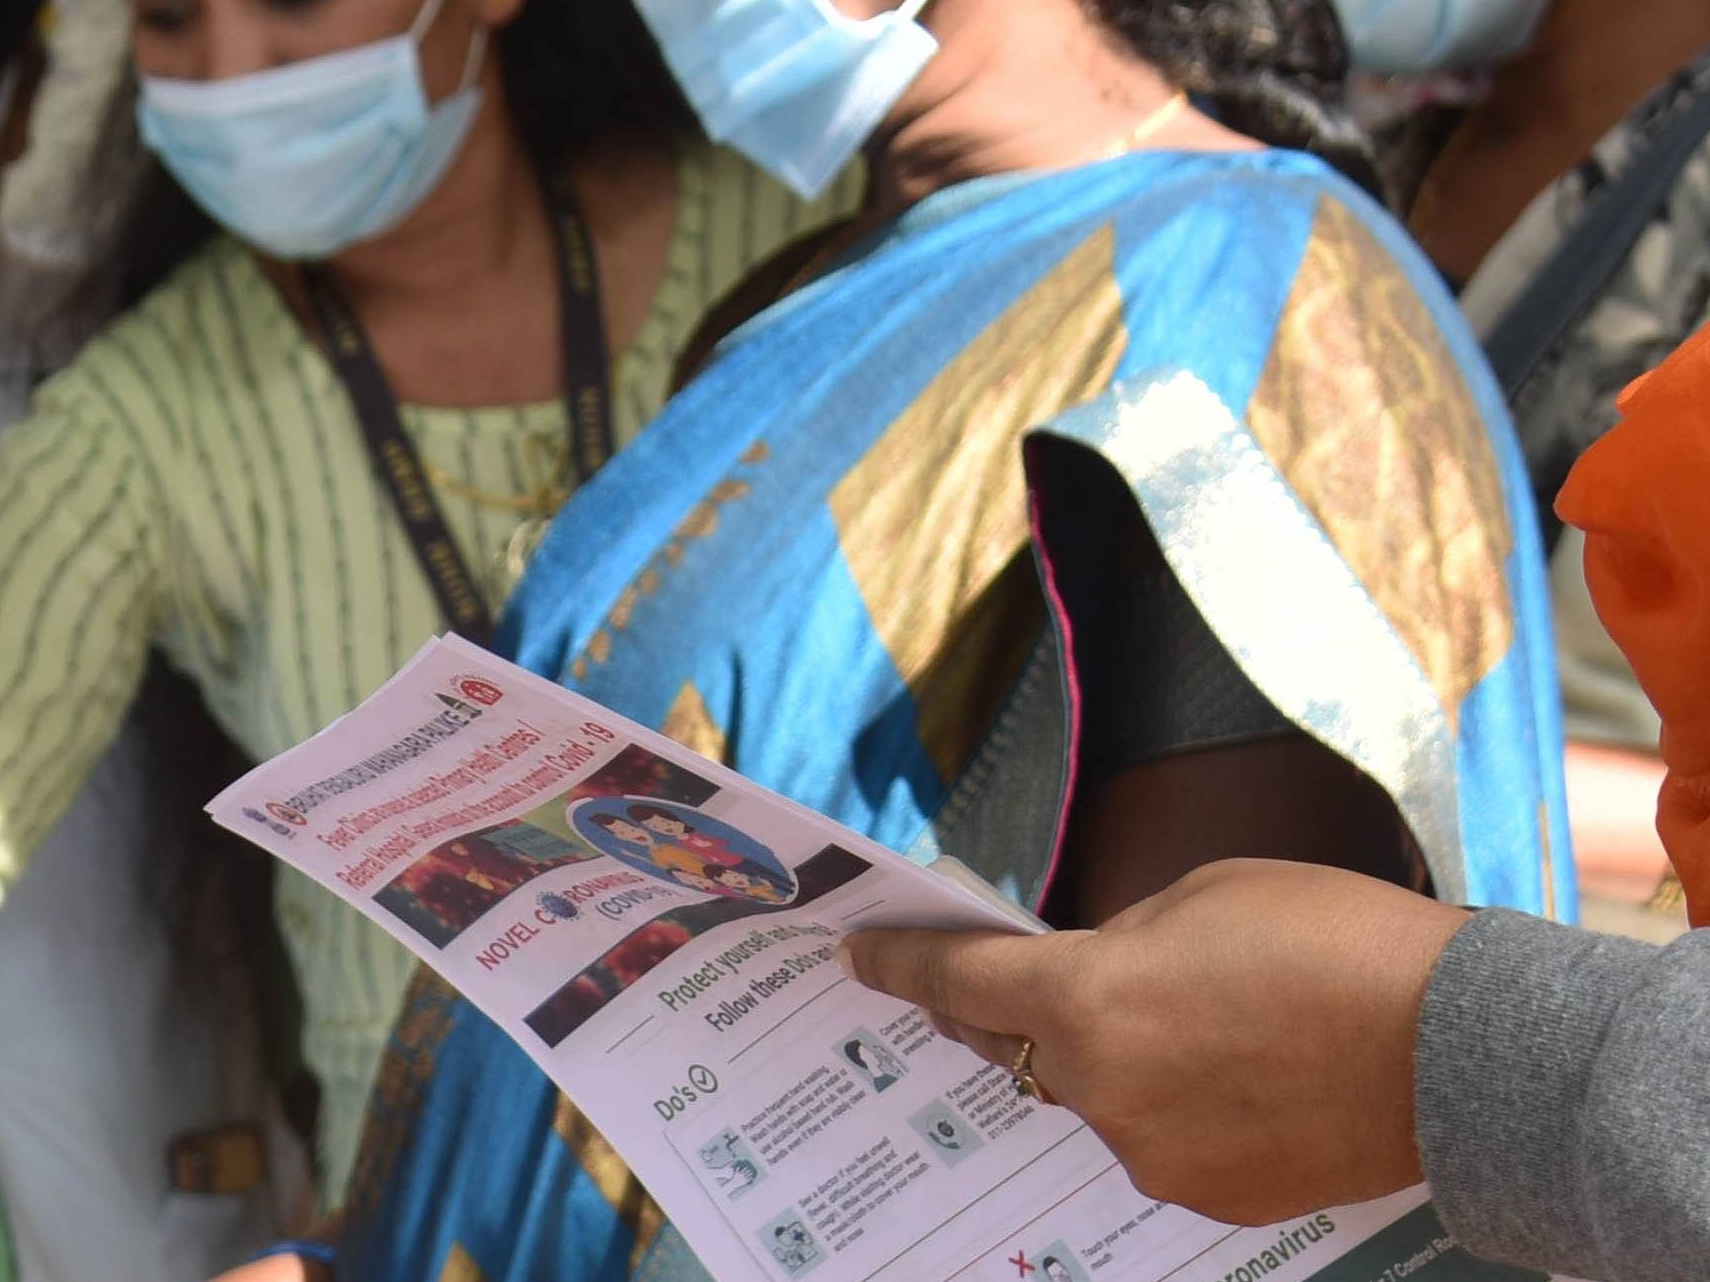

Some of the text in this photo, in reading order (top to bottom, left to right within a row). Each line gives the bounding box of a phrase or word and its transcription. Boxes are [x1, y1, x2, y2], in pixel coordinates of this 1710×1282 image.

[418, 707, 469, 744] PALIKE
[544, 736, 589, 772] Covid
[581, 720, 615, 745] 19
[317, 824, 355, 853] Fever
[476, 923, 539, 971] NOVEL
[659, 961, 726, 1011] Protect
[717, 930, 772, 973] yourself
[705, 991, 758, 1031] Follow
[750, 967, 796, 998] these
[653, 1084, 698, 1122] Do's
[740, 1111, 767, 1132] Practice
[764, 1092, 792, 1114] frequent
[788, 1081, 805, 1096] hand
[767, 1114, 787, 1130] hands
[785, 1103, 800, 1115] with
[770, 1126, 793, 1144] alcohol
[792, 1112, 812, 1128] based
[809, 1100, 827, 1116] hand
[766, 1147, 788, 1165] hands
[785, 1136, 803, 1150] even
[806, 1122, 822, 1136] they
[829, 1100, 852, 1119] visibly
[798, 1193, 813, 1206] See
[816, 1175, 839, 1193] doctor
[843, 1161, 858, 1174] you
[866, 1136, 890, 1155] unwell
[825, 1179, 855, 1202] difficult
[851, 1158, 885, 1184] breathing
[882, 1150, 897, 1162] and
[858, 1176, 885, 1198] visiting
[881, 1162, 905, 1180] doctor
[873, 1187, 894, 1204] cover
[891, 1176, 911, 1193] your
[906, 1161, 929, 1179] mouth
[833, 1226, 865, 1251] and nose
[1081, 1240, 1104, 1257] Touch
[1102, 1230, 1121, 1245] your
[1136, 1207, 1156, 1222] nose
[1090, 1252, 1114, 1270] mouth
[1382, 1268, 1397, 1282] 7
[1391, 1245, 1436, 1276] Control
